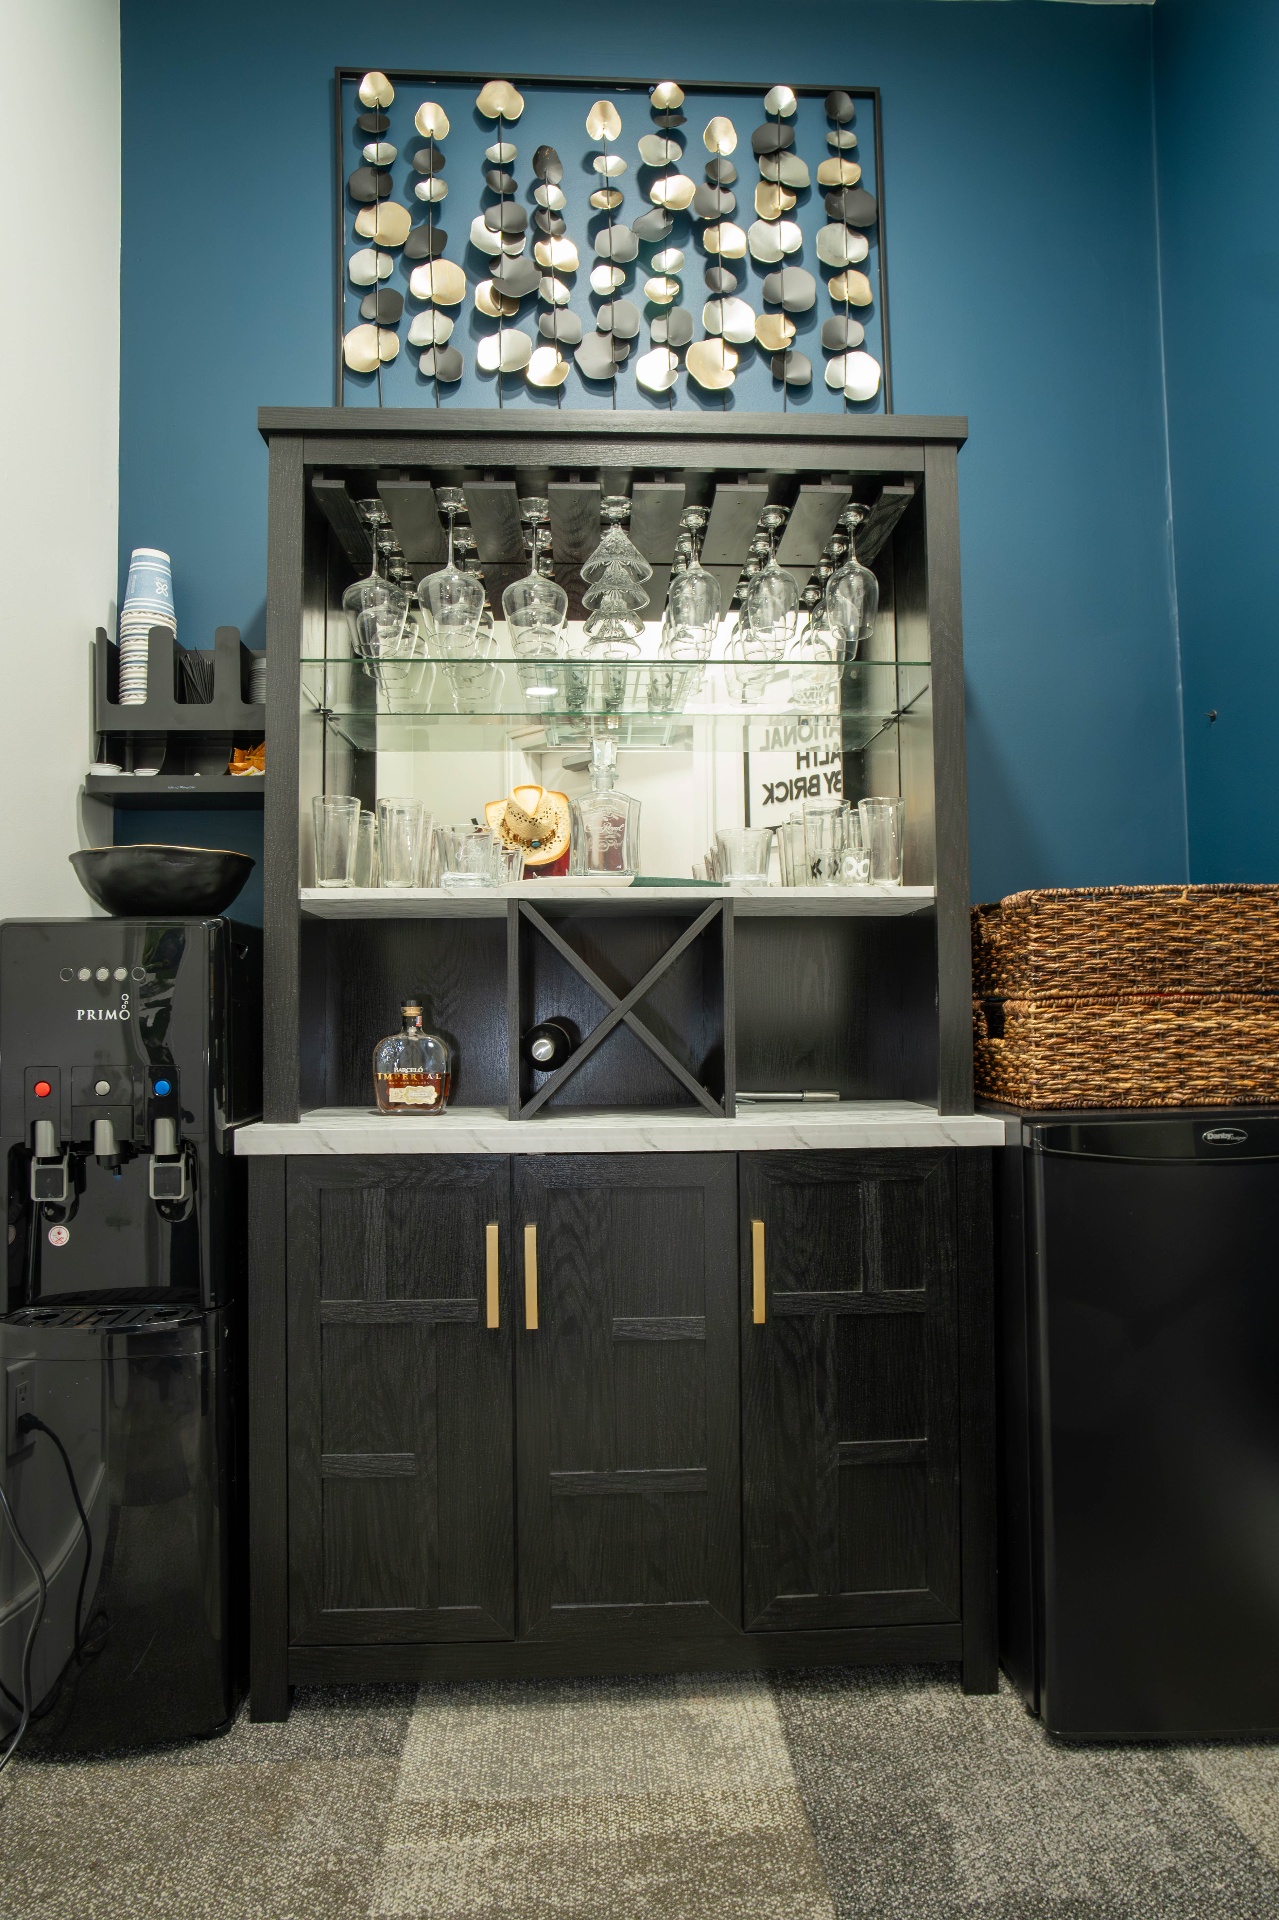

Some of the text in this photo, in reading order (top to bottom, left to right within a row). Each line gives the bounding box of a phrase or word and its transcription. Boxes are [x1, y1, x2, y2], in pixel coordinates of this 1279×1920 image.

[76, 1009, 131, 1021] PRIMO
[377, 1073, 442, 1081] IMPERIAL
[1207, 1132, 1232, 1140] Danby
